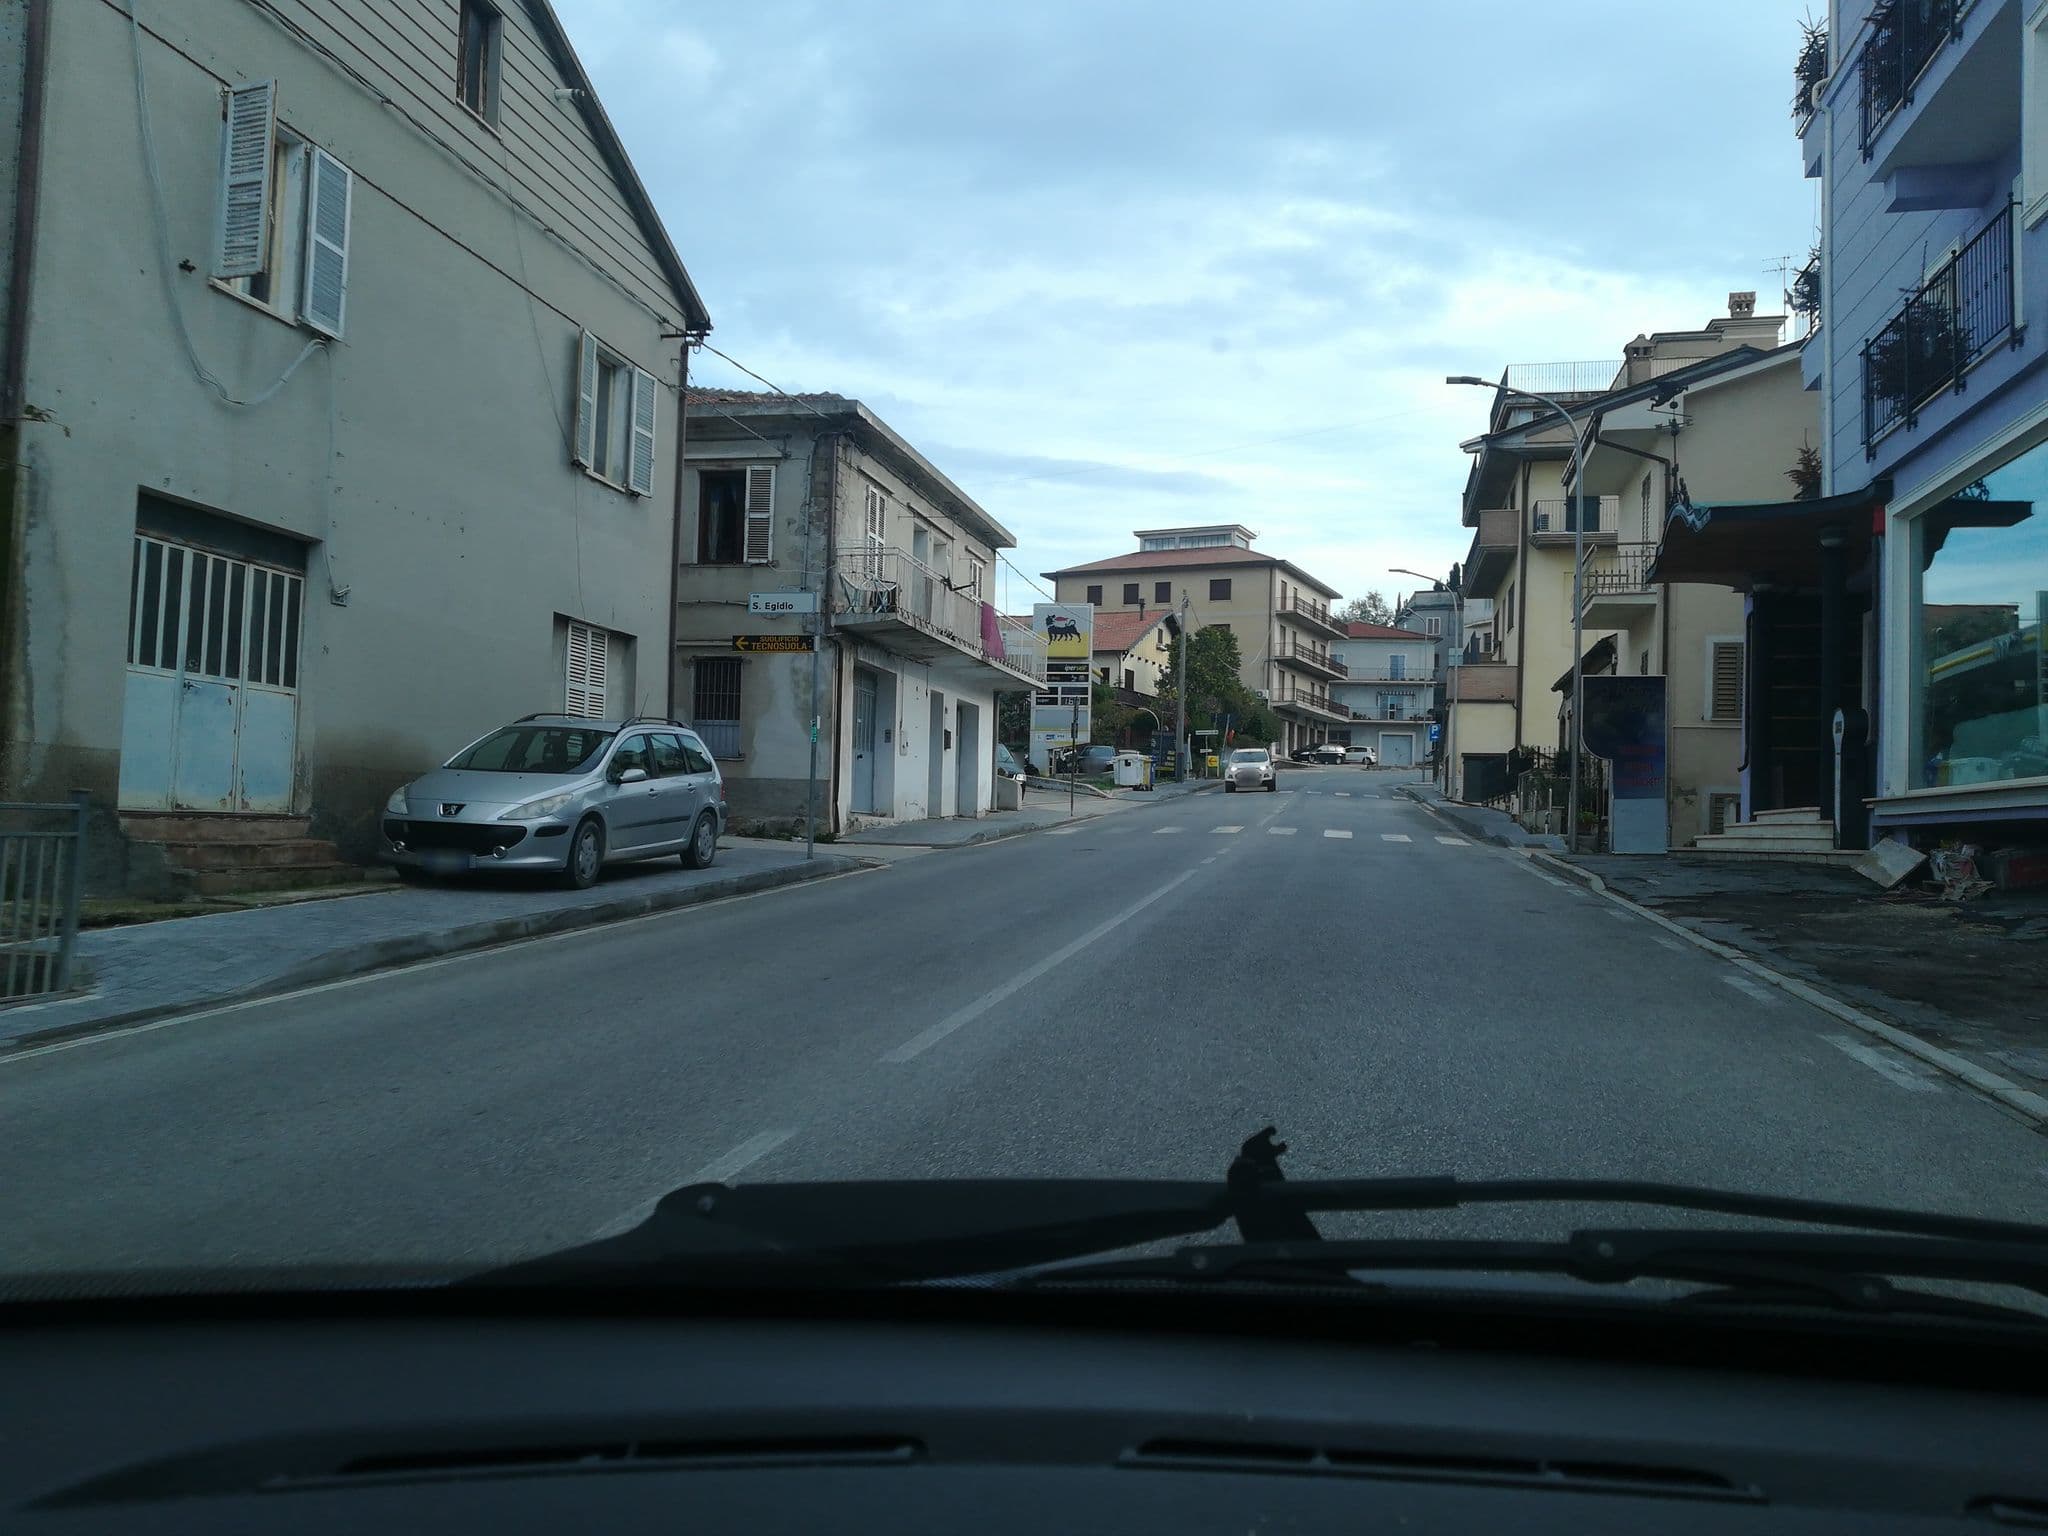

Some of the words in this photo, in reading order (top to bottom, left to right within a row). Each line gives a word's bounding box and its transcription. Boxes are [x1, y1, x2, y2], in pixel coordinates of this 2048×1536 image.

[752, 602, 762, 610] S.
[765, 602, 794, 611] Egidio
[752, 642, 807, 650] TECNOSUOLA
